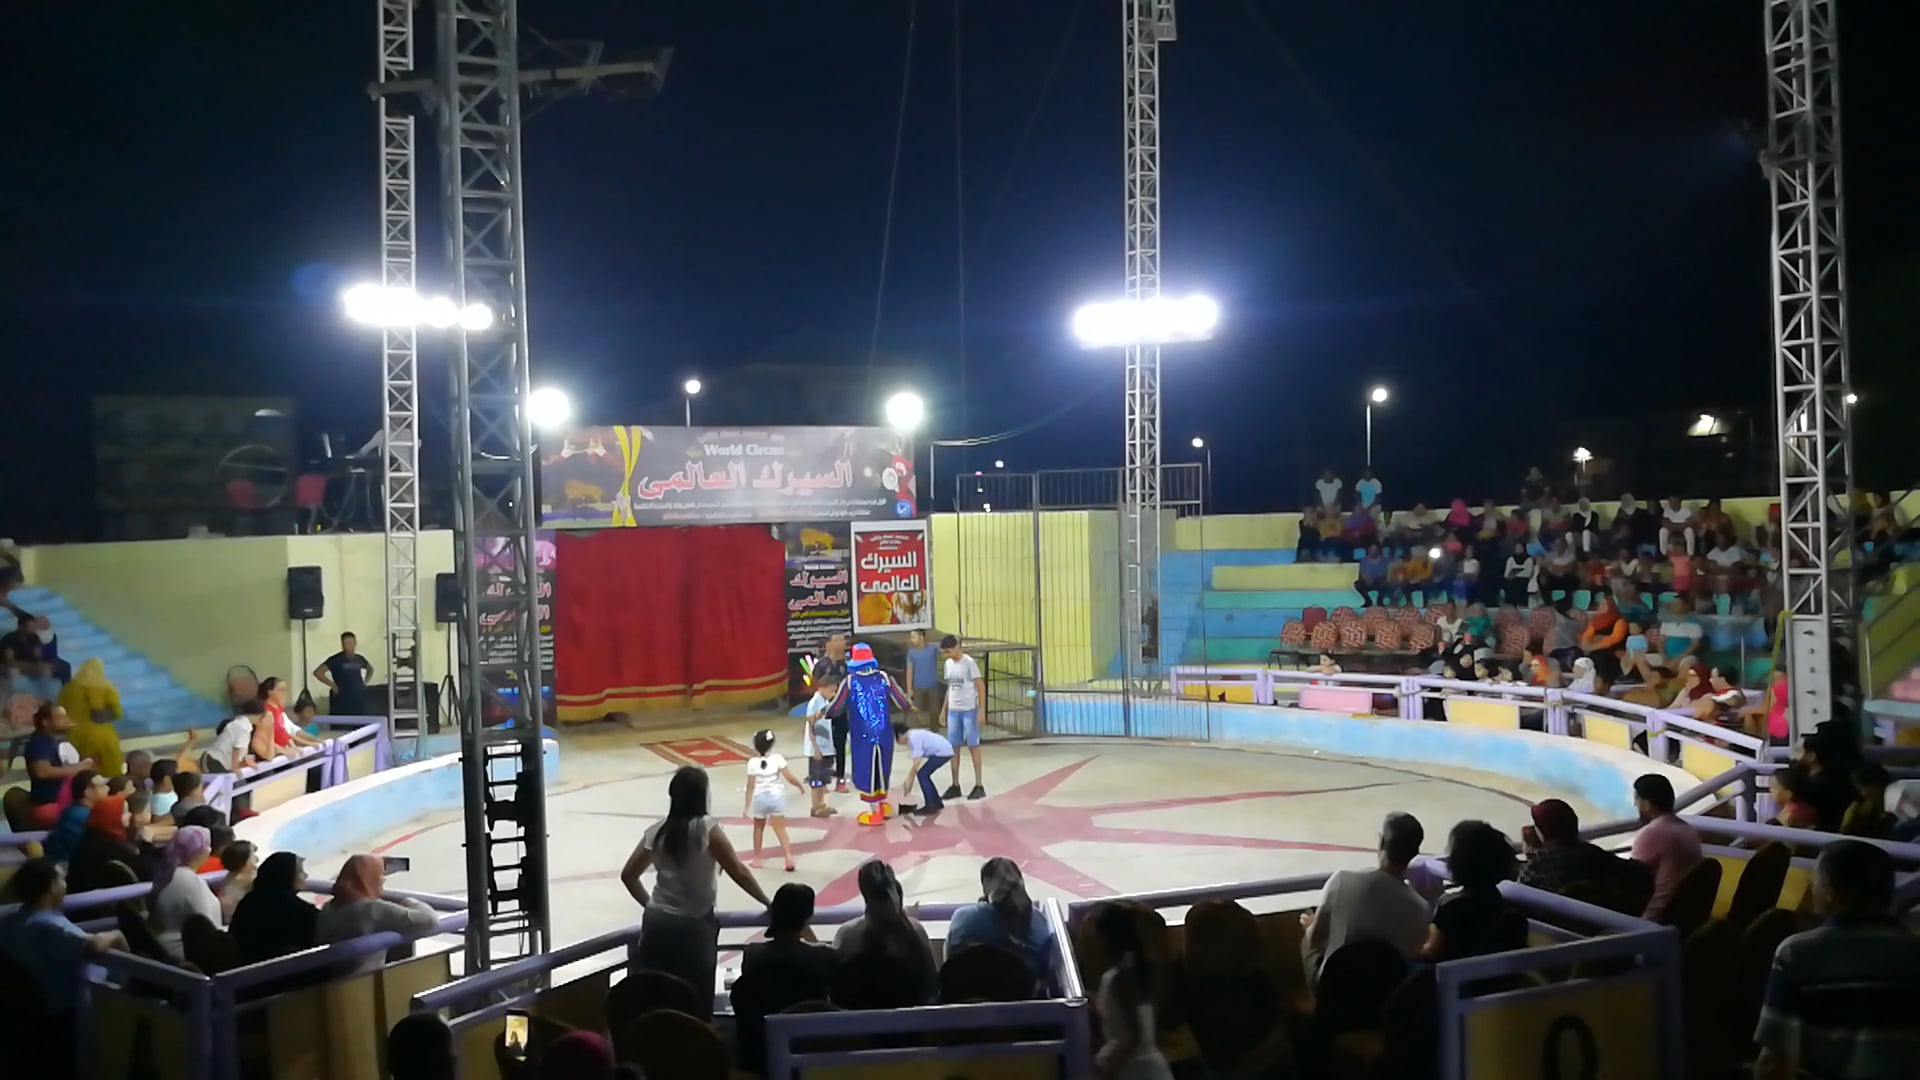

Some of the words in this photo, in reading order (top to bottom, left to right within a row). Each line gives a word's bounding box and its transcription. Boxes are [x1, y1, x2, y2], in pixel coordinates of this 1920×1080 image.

[703, 443, 742, 456] World
[752, 457, 853, 497] السيرك
[860, 550, 917, 574] السيرك
[789, 569, 849, 589] السيرك
